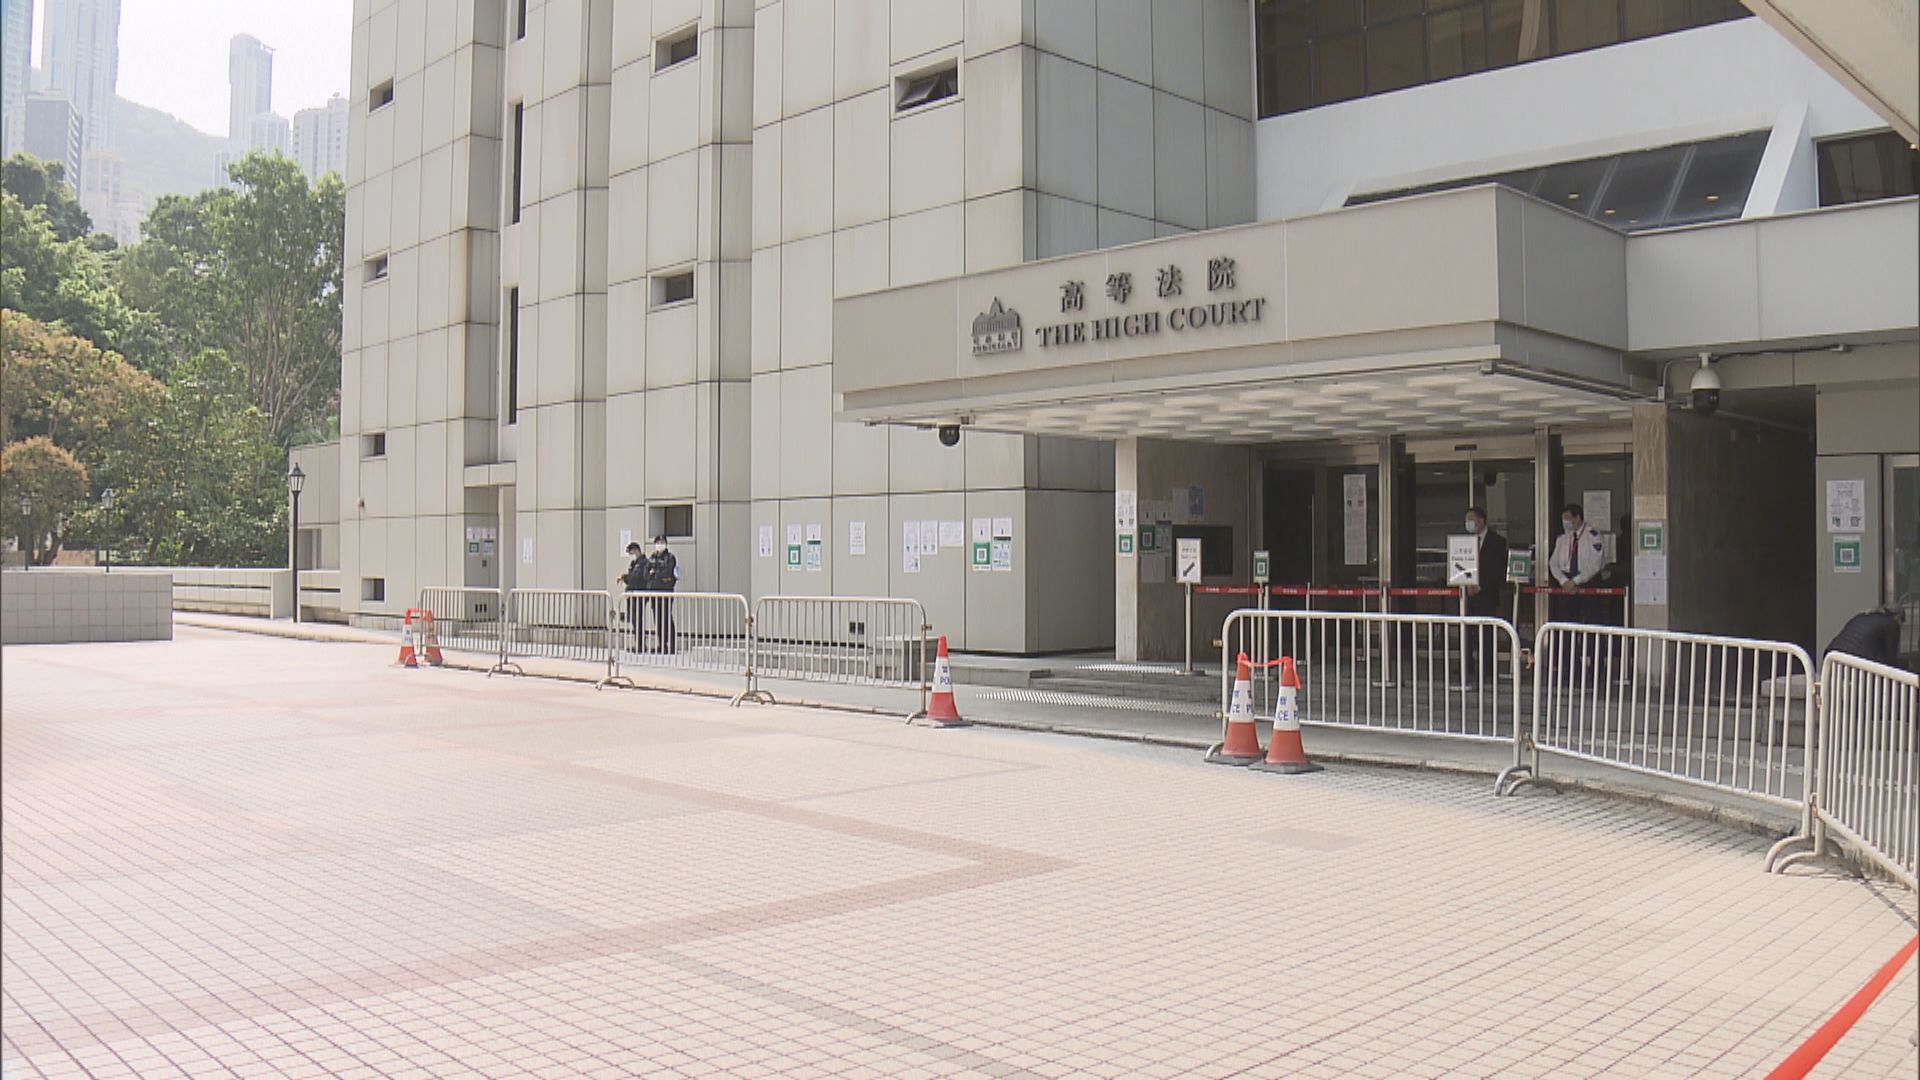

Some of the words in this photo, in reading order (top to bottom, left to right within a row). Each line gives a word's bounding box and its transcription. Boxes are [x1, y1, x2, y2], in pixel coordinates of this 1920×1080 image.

[1059, 256, 1236, 313] 高等法院
[1035, 321, 1085, 348] THE
[1091, 311, 1159, 341] HIGH
[1166, 297, 1265, 332] COURT
